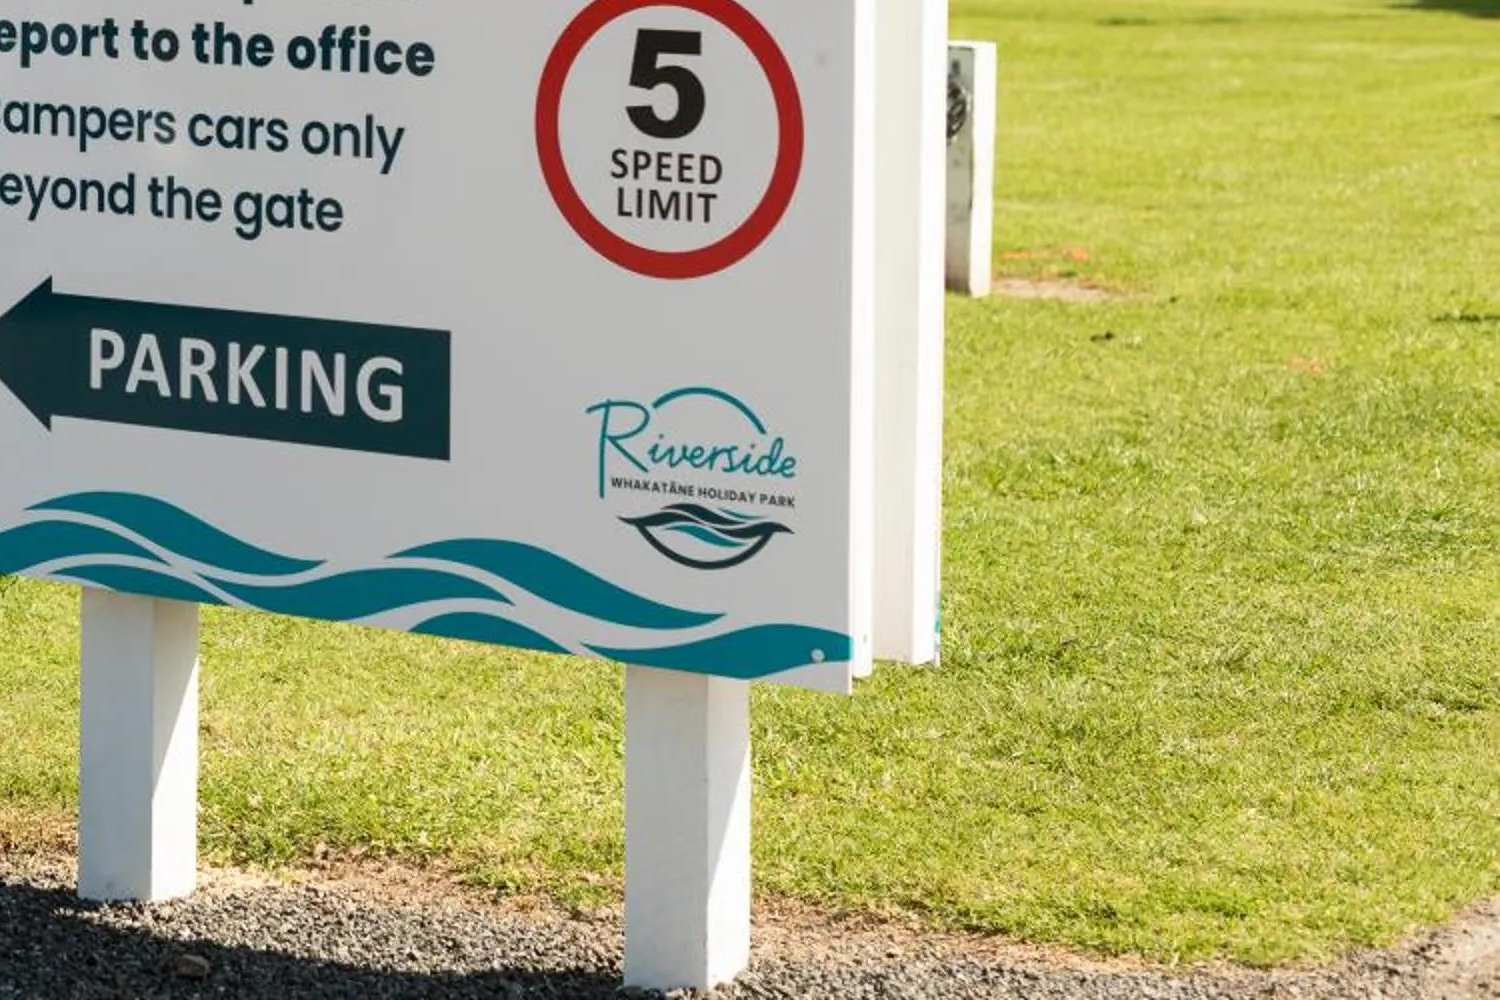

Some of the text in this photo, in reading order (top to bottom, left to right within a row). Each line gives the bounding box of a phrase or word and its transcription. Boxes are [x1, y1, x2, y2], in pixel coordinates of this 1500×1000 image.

[130, 19, 180, 63] to
[191, 21, 275, 68] the
[286, 24, 435, 77] office
[625, 27, 706, 140] 5
[187, 113, 289, 153] cars
[301, 113, 405, 175] only
[610, 148, 723, 185] SPEED
[147, 175, 223, 223] the
[233, 188, 344, 241] gate
[617, 186, 718, 224] LIMIT
[89, 327, 404, 423] PARKING
[585, 398, 797, 499] Riverside
[697, 487, 757, 504] HOLIDAY
[759, 493, 795, 509] PARK
